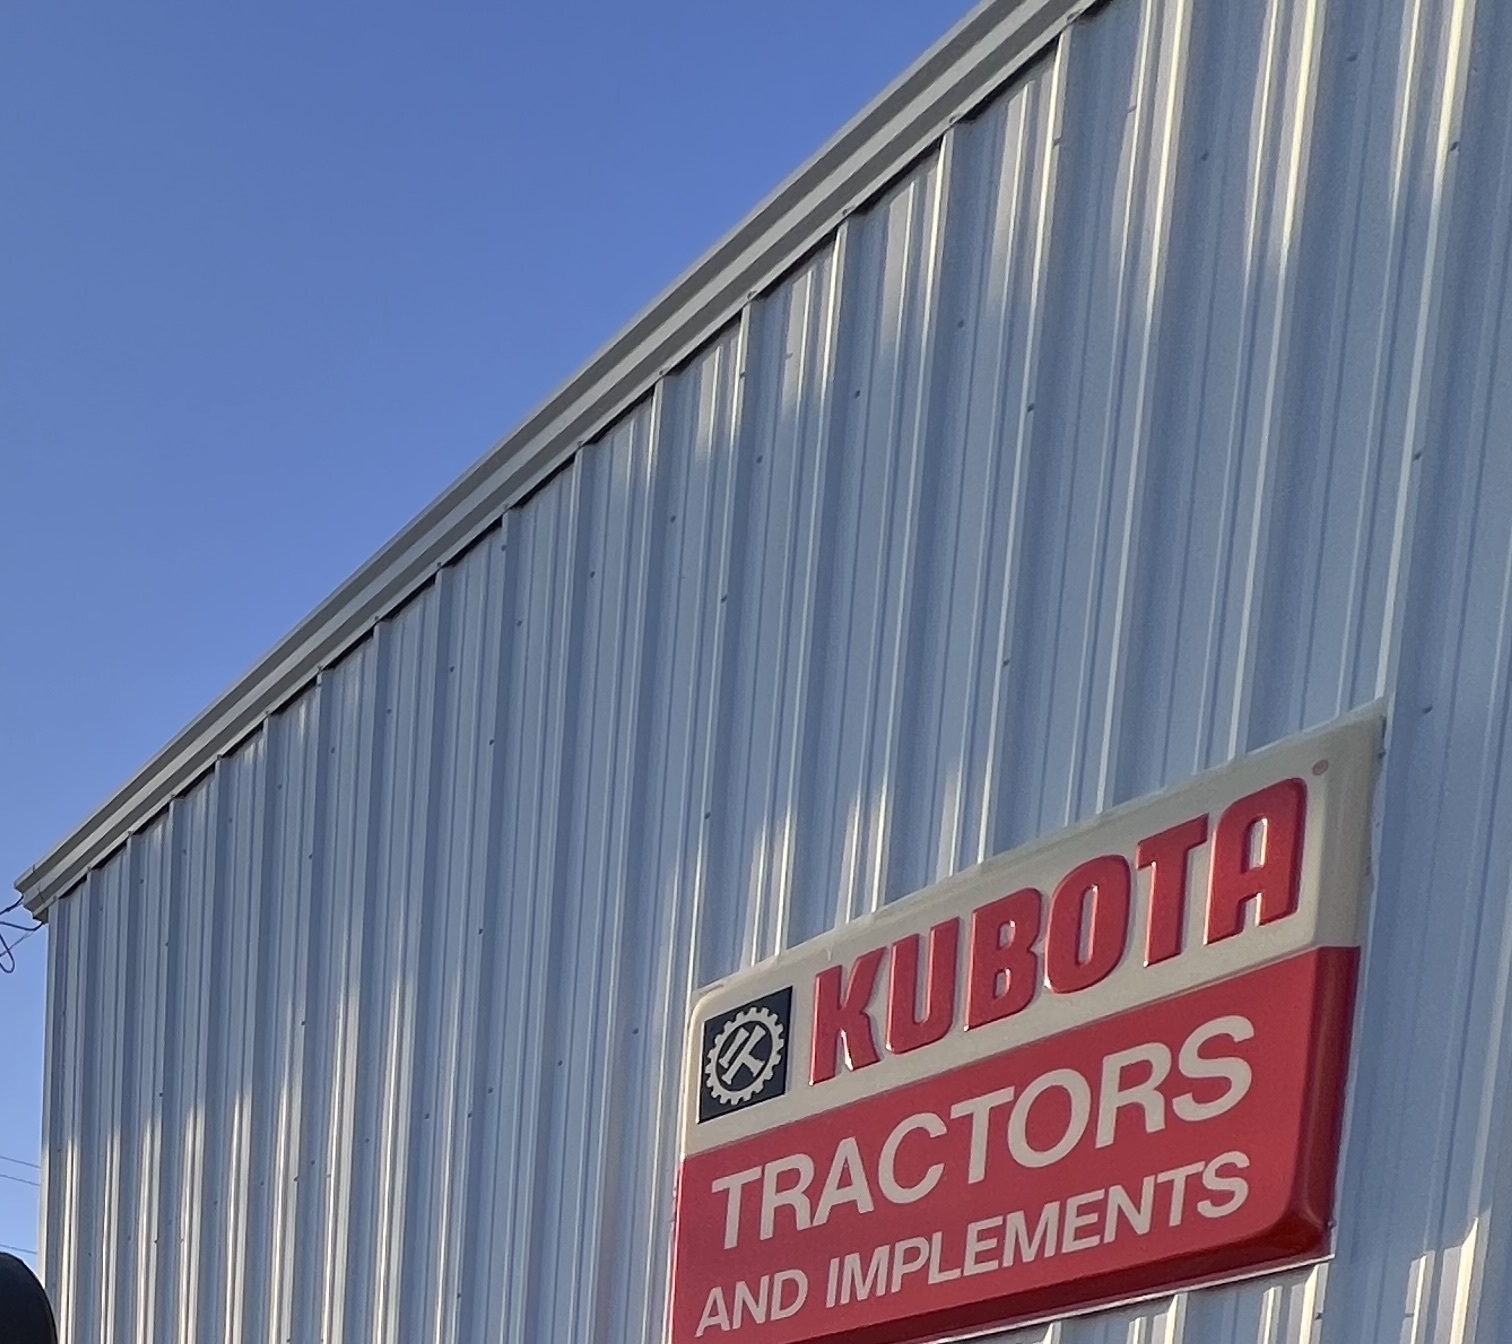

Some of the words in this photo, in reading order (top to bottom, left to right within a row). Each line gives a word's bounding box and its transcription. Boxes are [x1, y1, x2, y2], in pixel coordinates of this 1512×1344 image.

[808, 777, 1308, 1086] KUBOTA
[694, 1269, 809, 1338] AND
[827, 1151, 1251, 1309] IMPLEMENTS
[711, 1014, 1256, 1250] TRACTORS
